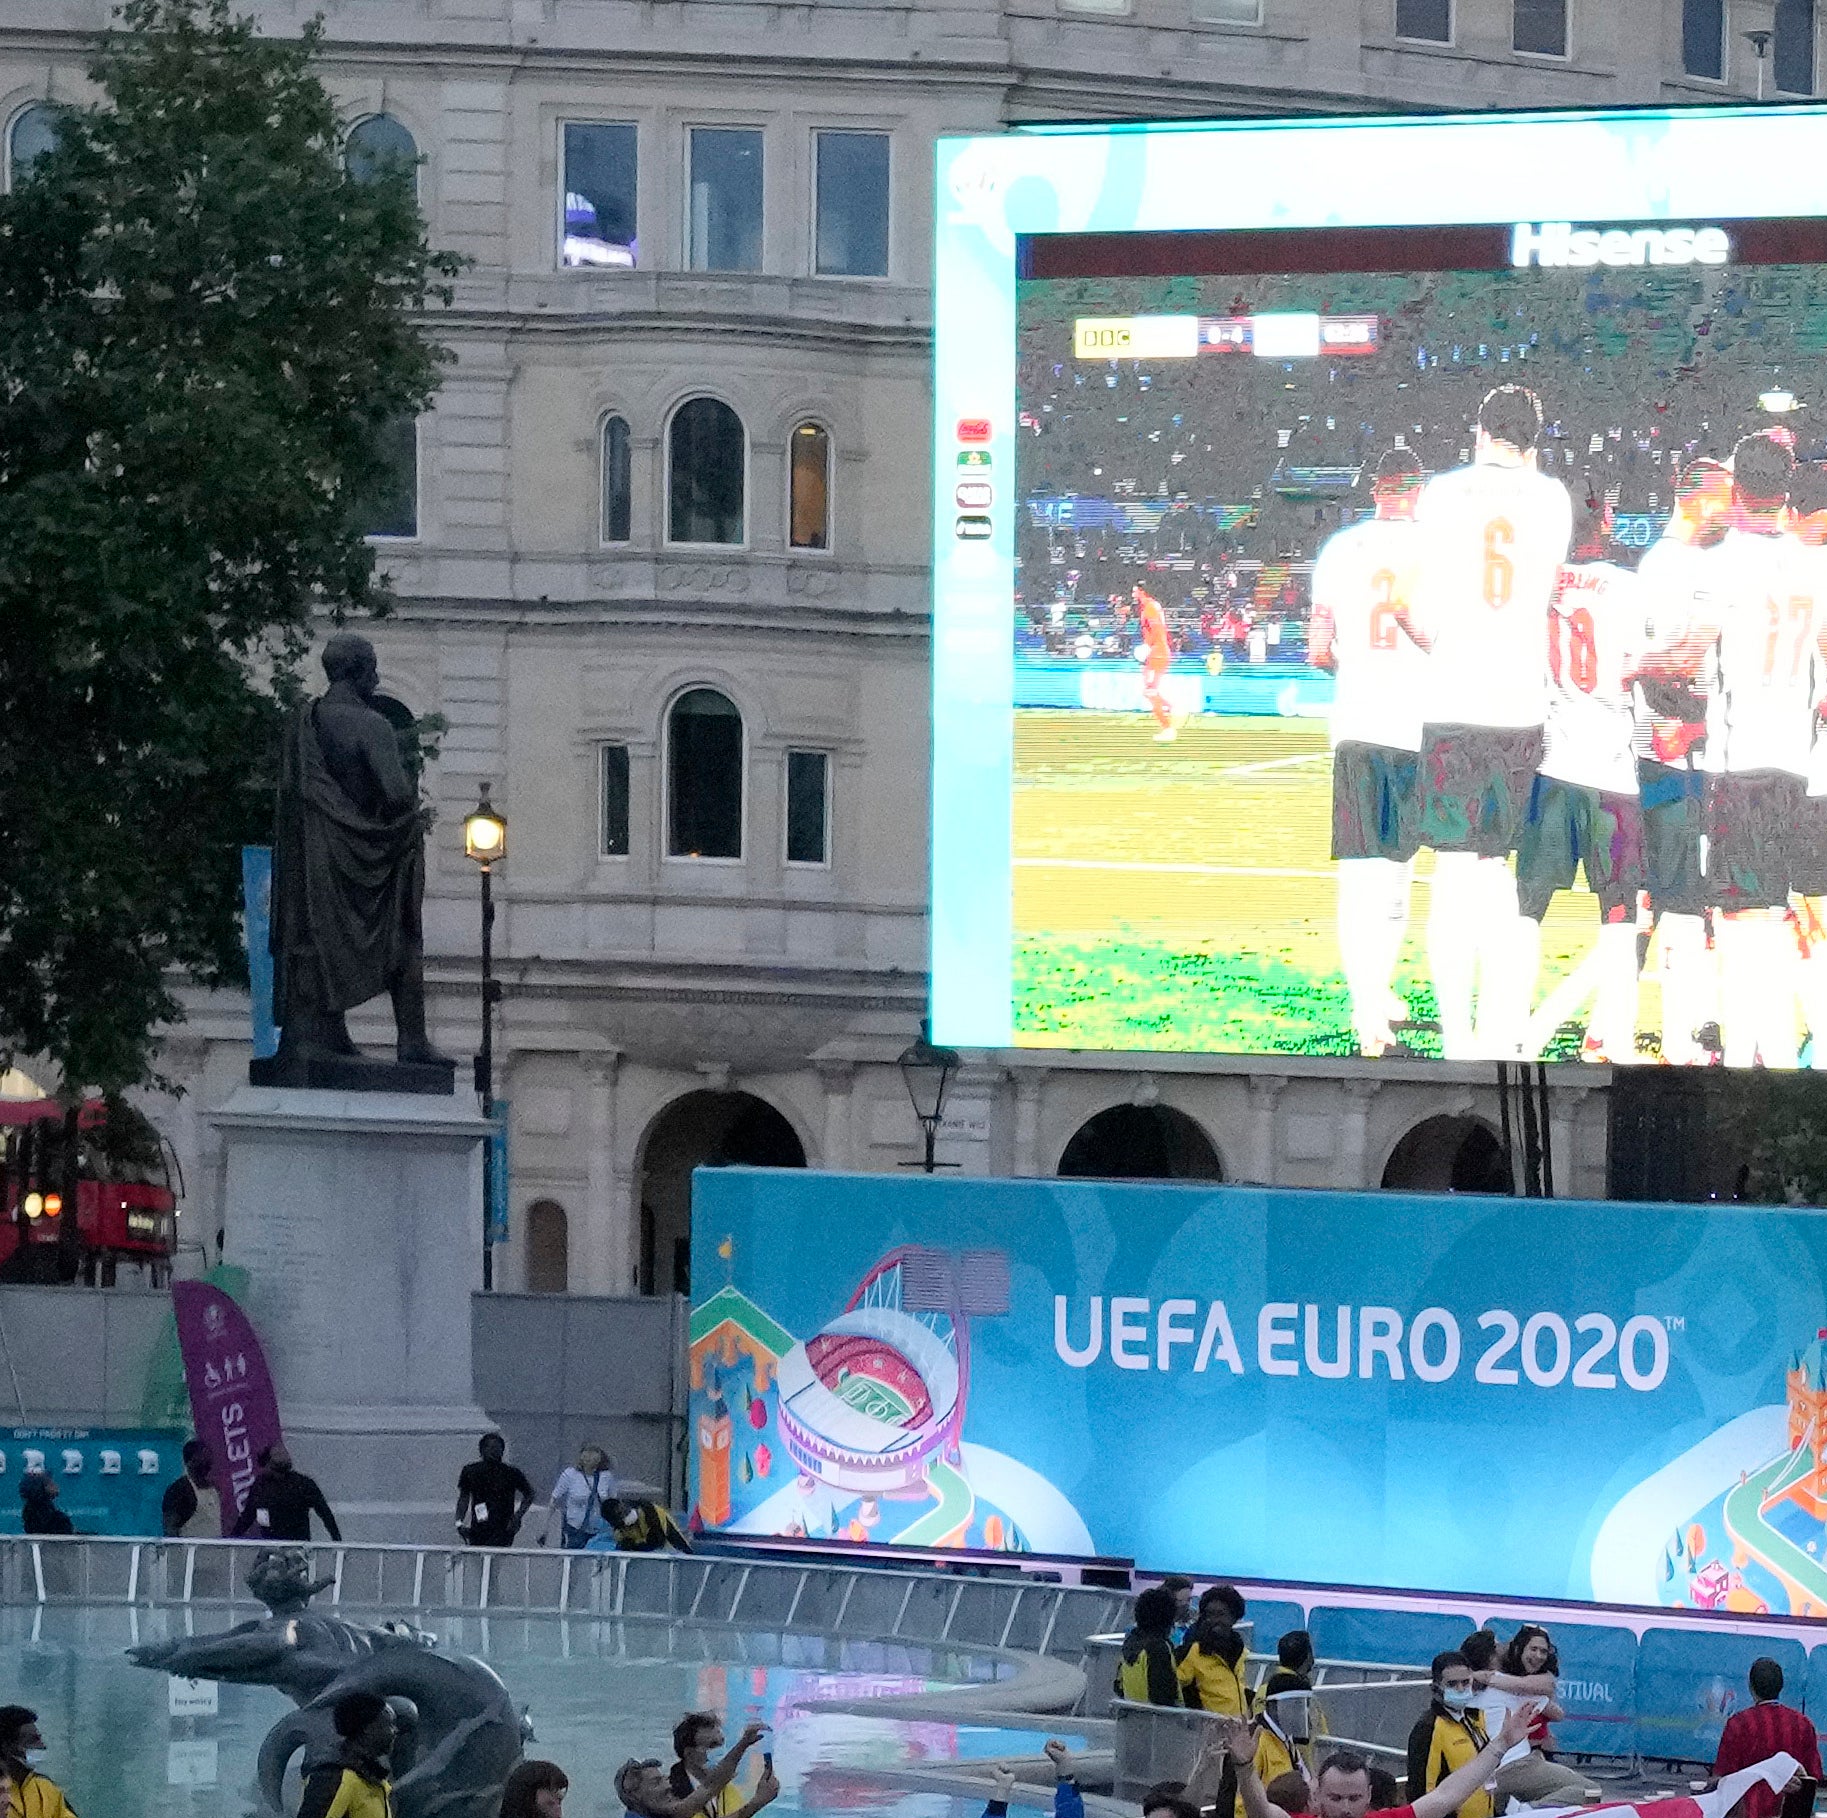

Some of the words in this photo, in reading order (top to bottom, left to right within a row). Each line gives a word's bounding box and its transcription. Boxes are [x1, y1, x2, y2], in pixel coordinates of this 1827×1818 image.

[1512, 222, 1729, 267] Hisense
[1483, 516, 1515, 609] 6
[1054, 1295, 1243, 1375] UEFA
[1257, 1302, 1461, 1383] EURO
[1474, 1309, 1670, 1392] 2020
